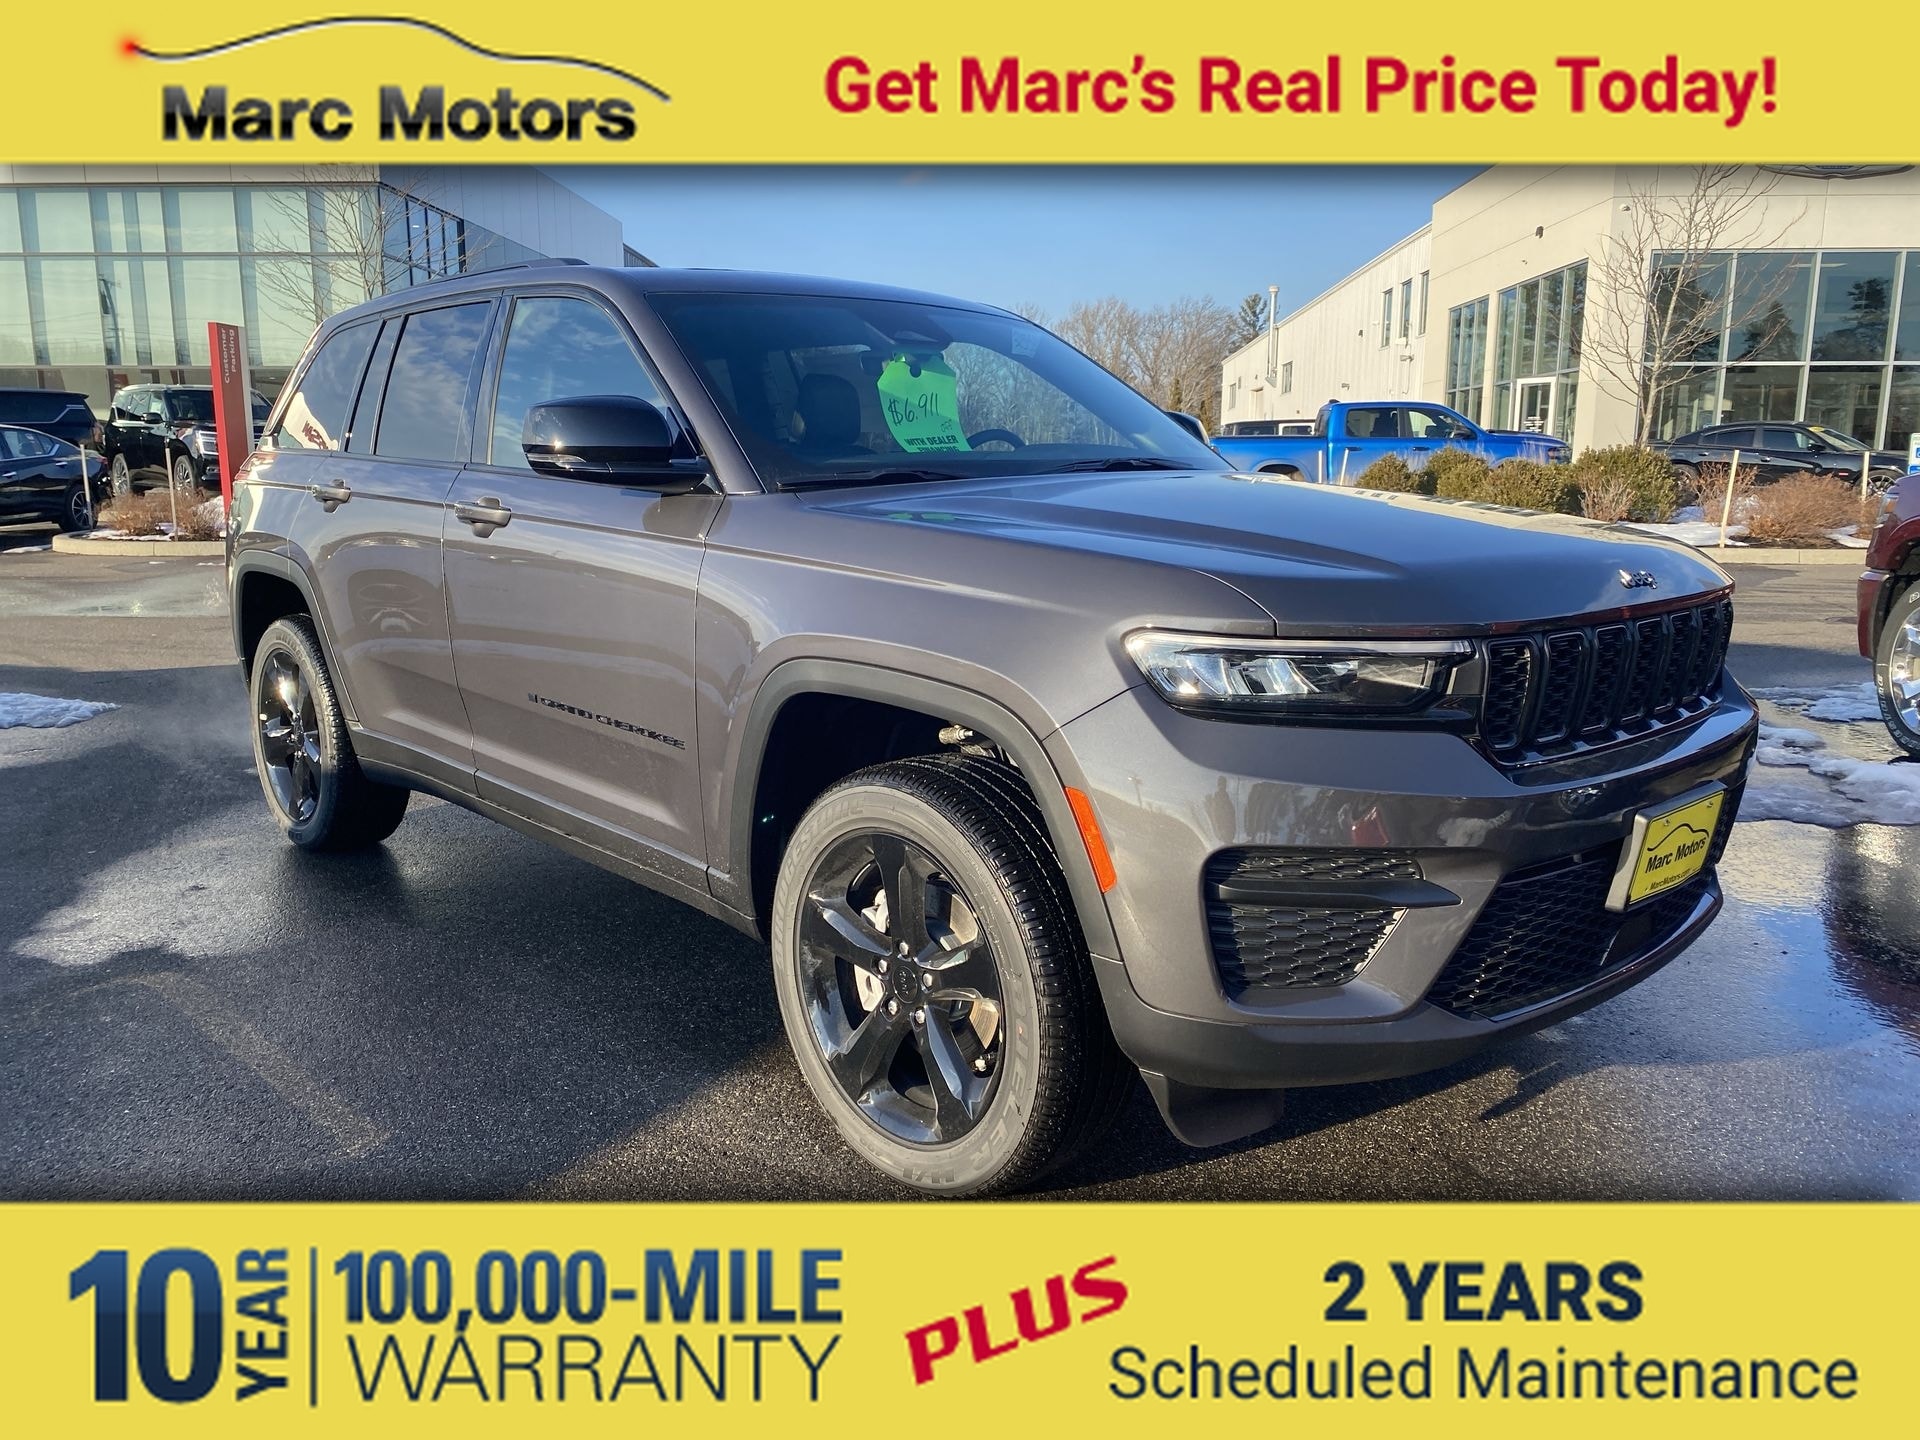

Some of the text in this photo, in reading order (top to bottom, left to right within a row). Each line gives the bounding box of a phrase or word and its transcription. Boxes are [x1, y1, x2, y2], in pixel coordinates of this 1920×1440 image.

[222, 328, 230, 384] Customer
[904, 434, 959, 447] WITH DEALER
[1618, 569, 1658, 590] Jeep
[540, 697, 686, 751] GRAND CHEROKEE
[1645, 837, 1707, 874] Marc Motors
